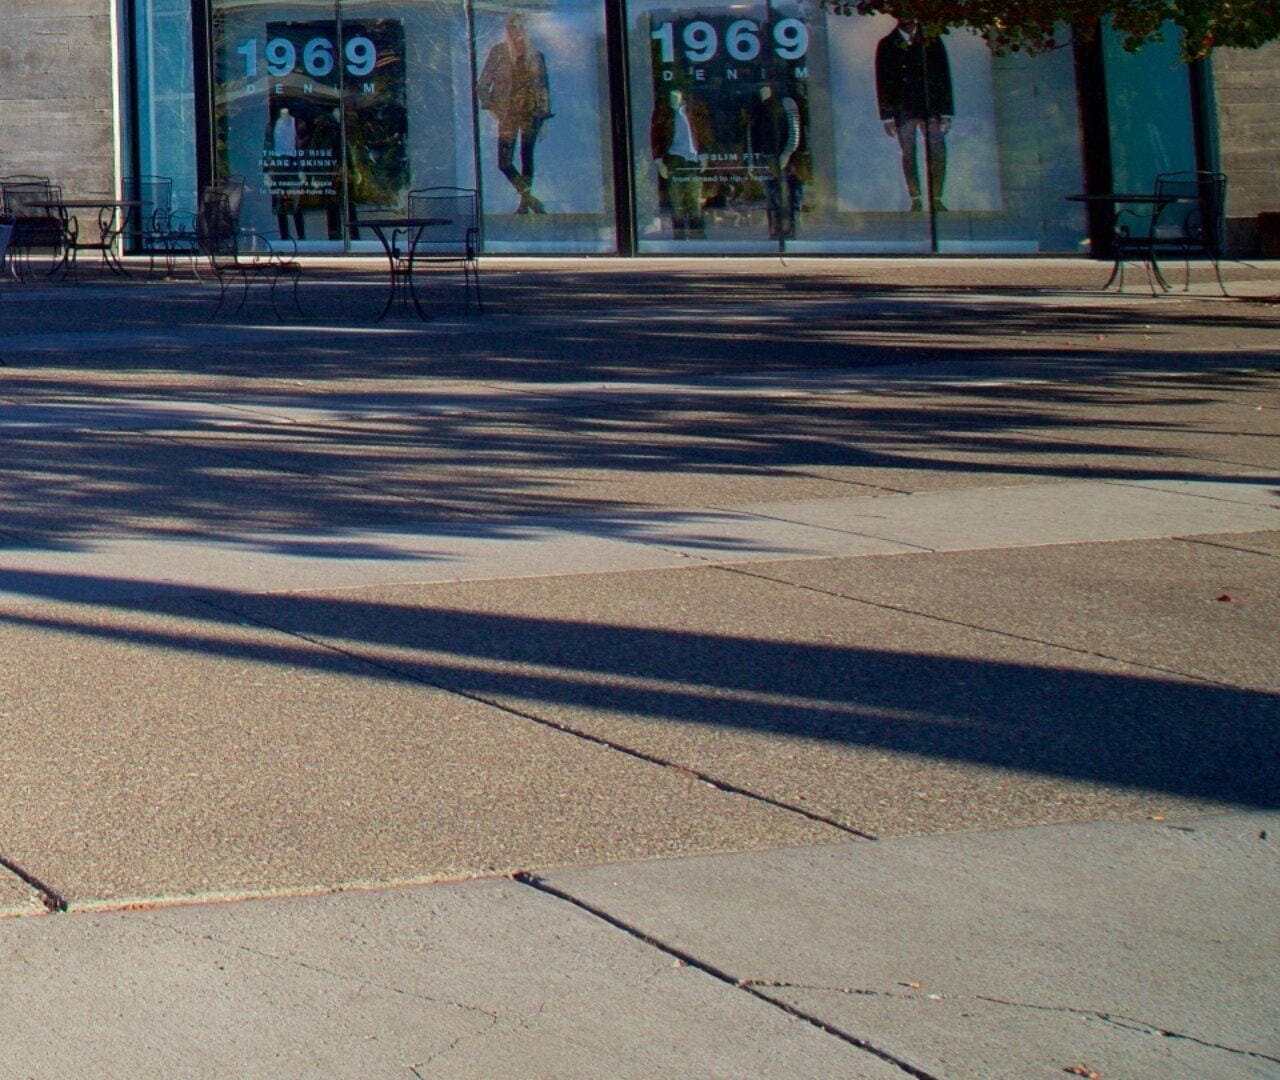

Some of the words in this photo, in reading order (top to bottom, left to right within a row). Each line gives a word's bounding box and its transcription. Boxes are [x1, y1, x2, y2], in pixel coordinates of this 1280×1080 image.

[651, 18, 809, 63] 1969
[237, 36, 377, 77] 1969
[663, 67, 808, 81] DENIM
[246, 82, 375, 94] DENIM
[258, 159, 289, 167] FLARE
[299, 159, 338, 167] SKINNY
[710, 153, 738, 161] SLIM
